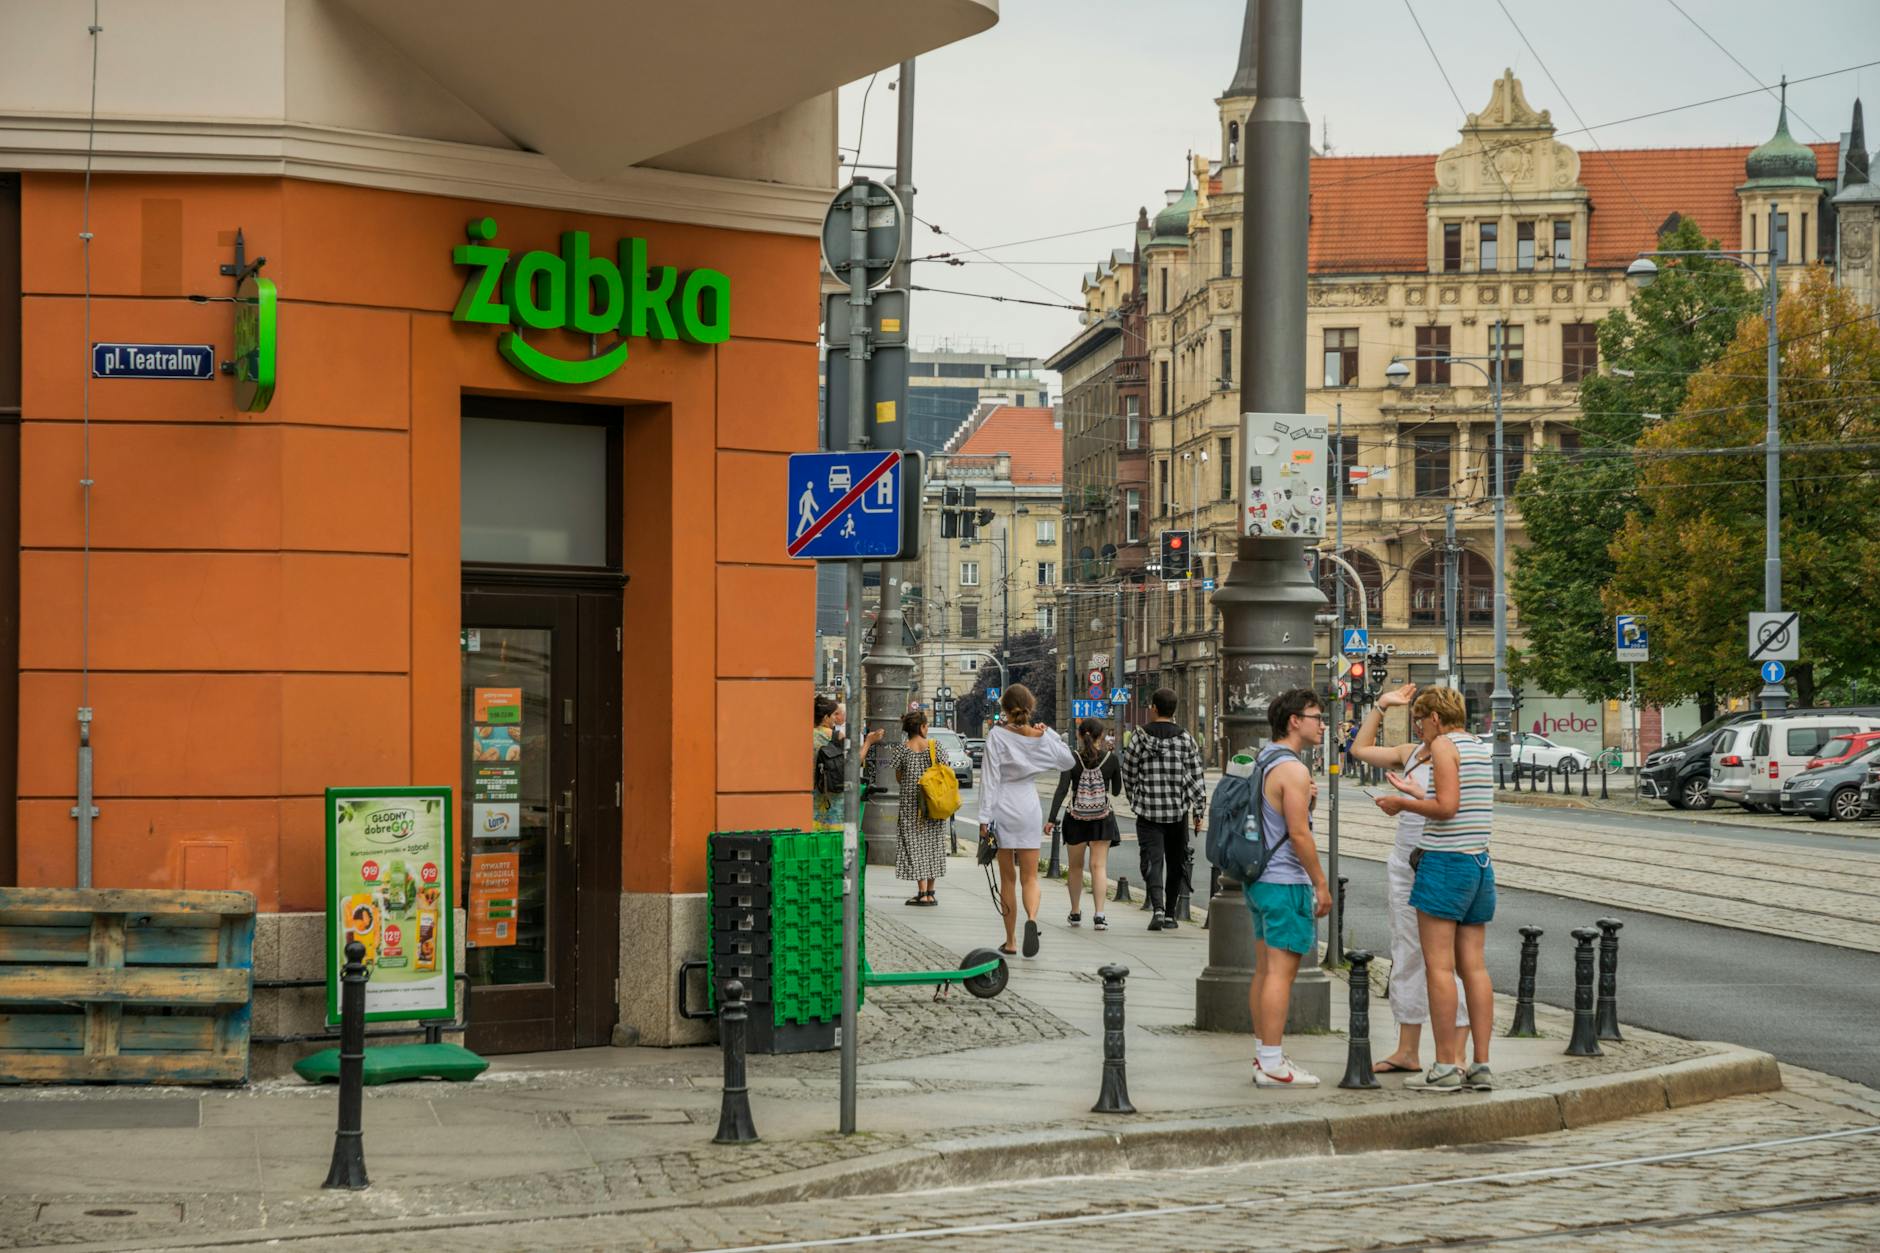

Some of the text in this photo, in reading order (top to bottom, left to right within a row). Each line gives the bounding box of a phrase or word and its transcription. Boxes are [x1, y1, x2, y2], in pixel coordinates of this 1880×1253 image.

[452, 217, 731, 345] żabka
[105, 348, 202, 374] pl. Teatralny
[1092, 674, 1102, 682] 30
[1543, 712, 1597, 733] hebe
[372, 811, 407, 823] GŁODNY
